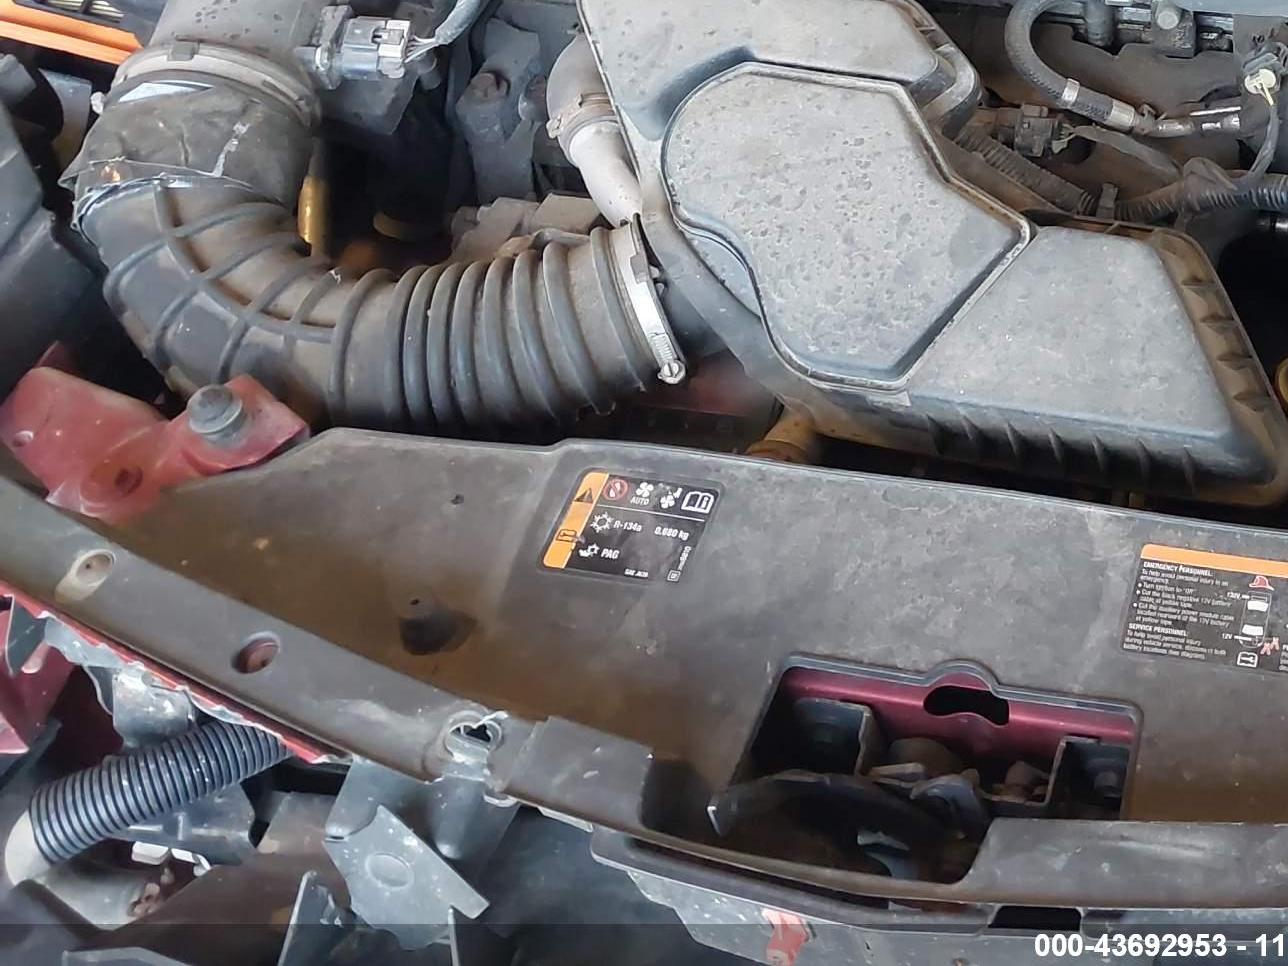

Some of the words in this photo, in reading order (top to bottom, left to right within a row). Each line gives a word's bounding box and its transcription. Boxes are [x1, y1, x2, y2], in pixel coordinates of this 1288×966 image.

[630, 496, 649, 506] AUTO
[613, 521, 642, 532] R-134a
[678, 530, 690, 541] kg
[600, 548, 620, 559] PAG
